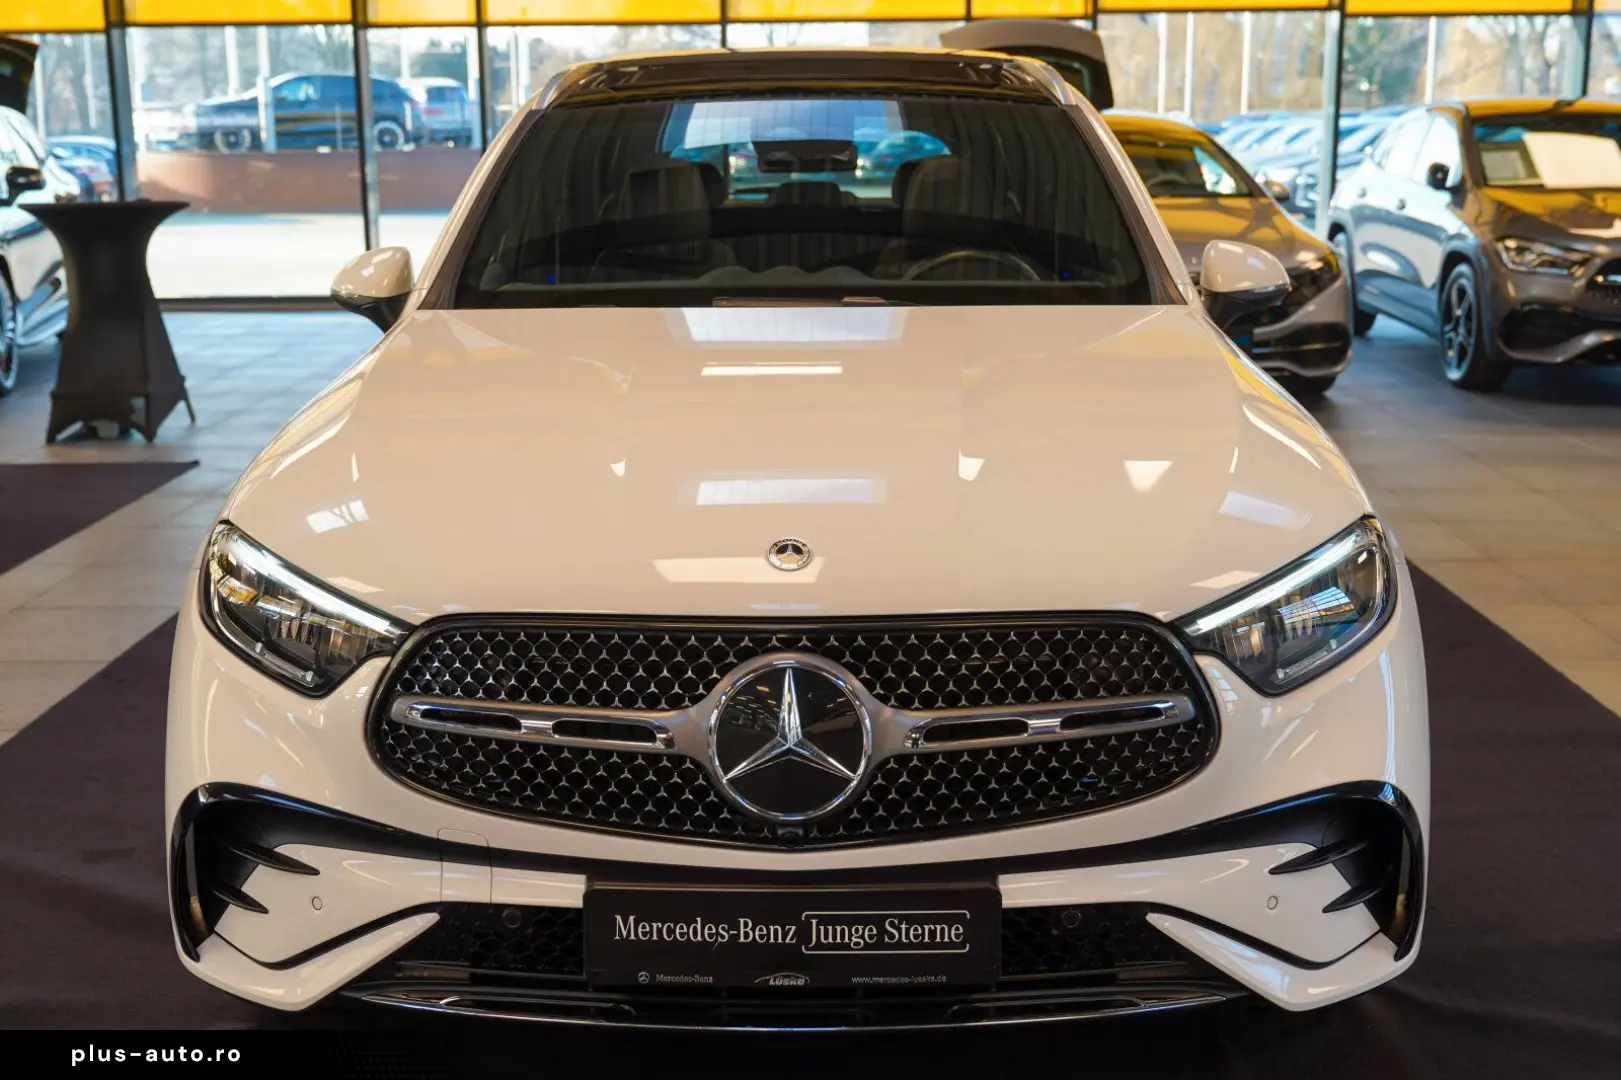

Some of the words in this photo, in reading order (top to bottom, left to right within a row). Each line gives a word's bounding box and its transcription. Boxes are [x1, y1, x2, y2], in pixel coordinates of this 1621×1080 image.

[613, 914, 798, 944] Mercedes-Benz
[808, 918, 878, 949] Junge
[884, 917, 964, 944] Sterne
[655, 973, 713, 983] Mercedes-Benz
